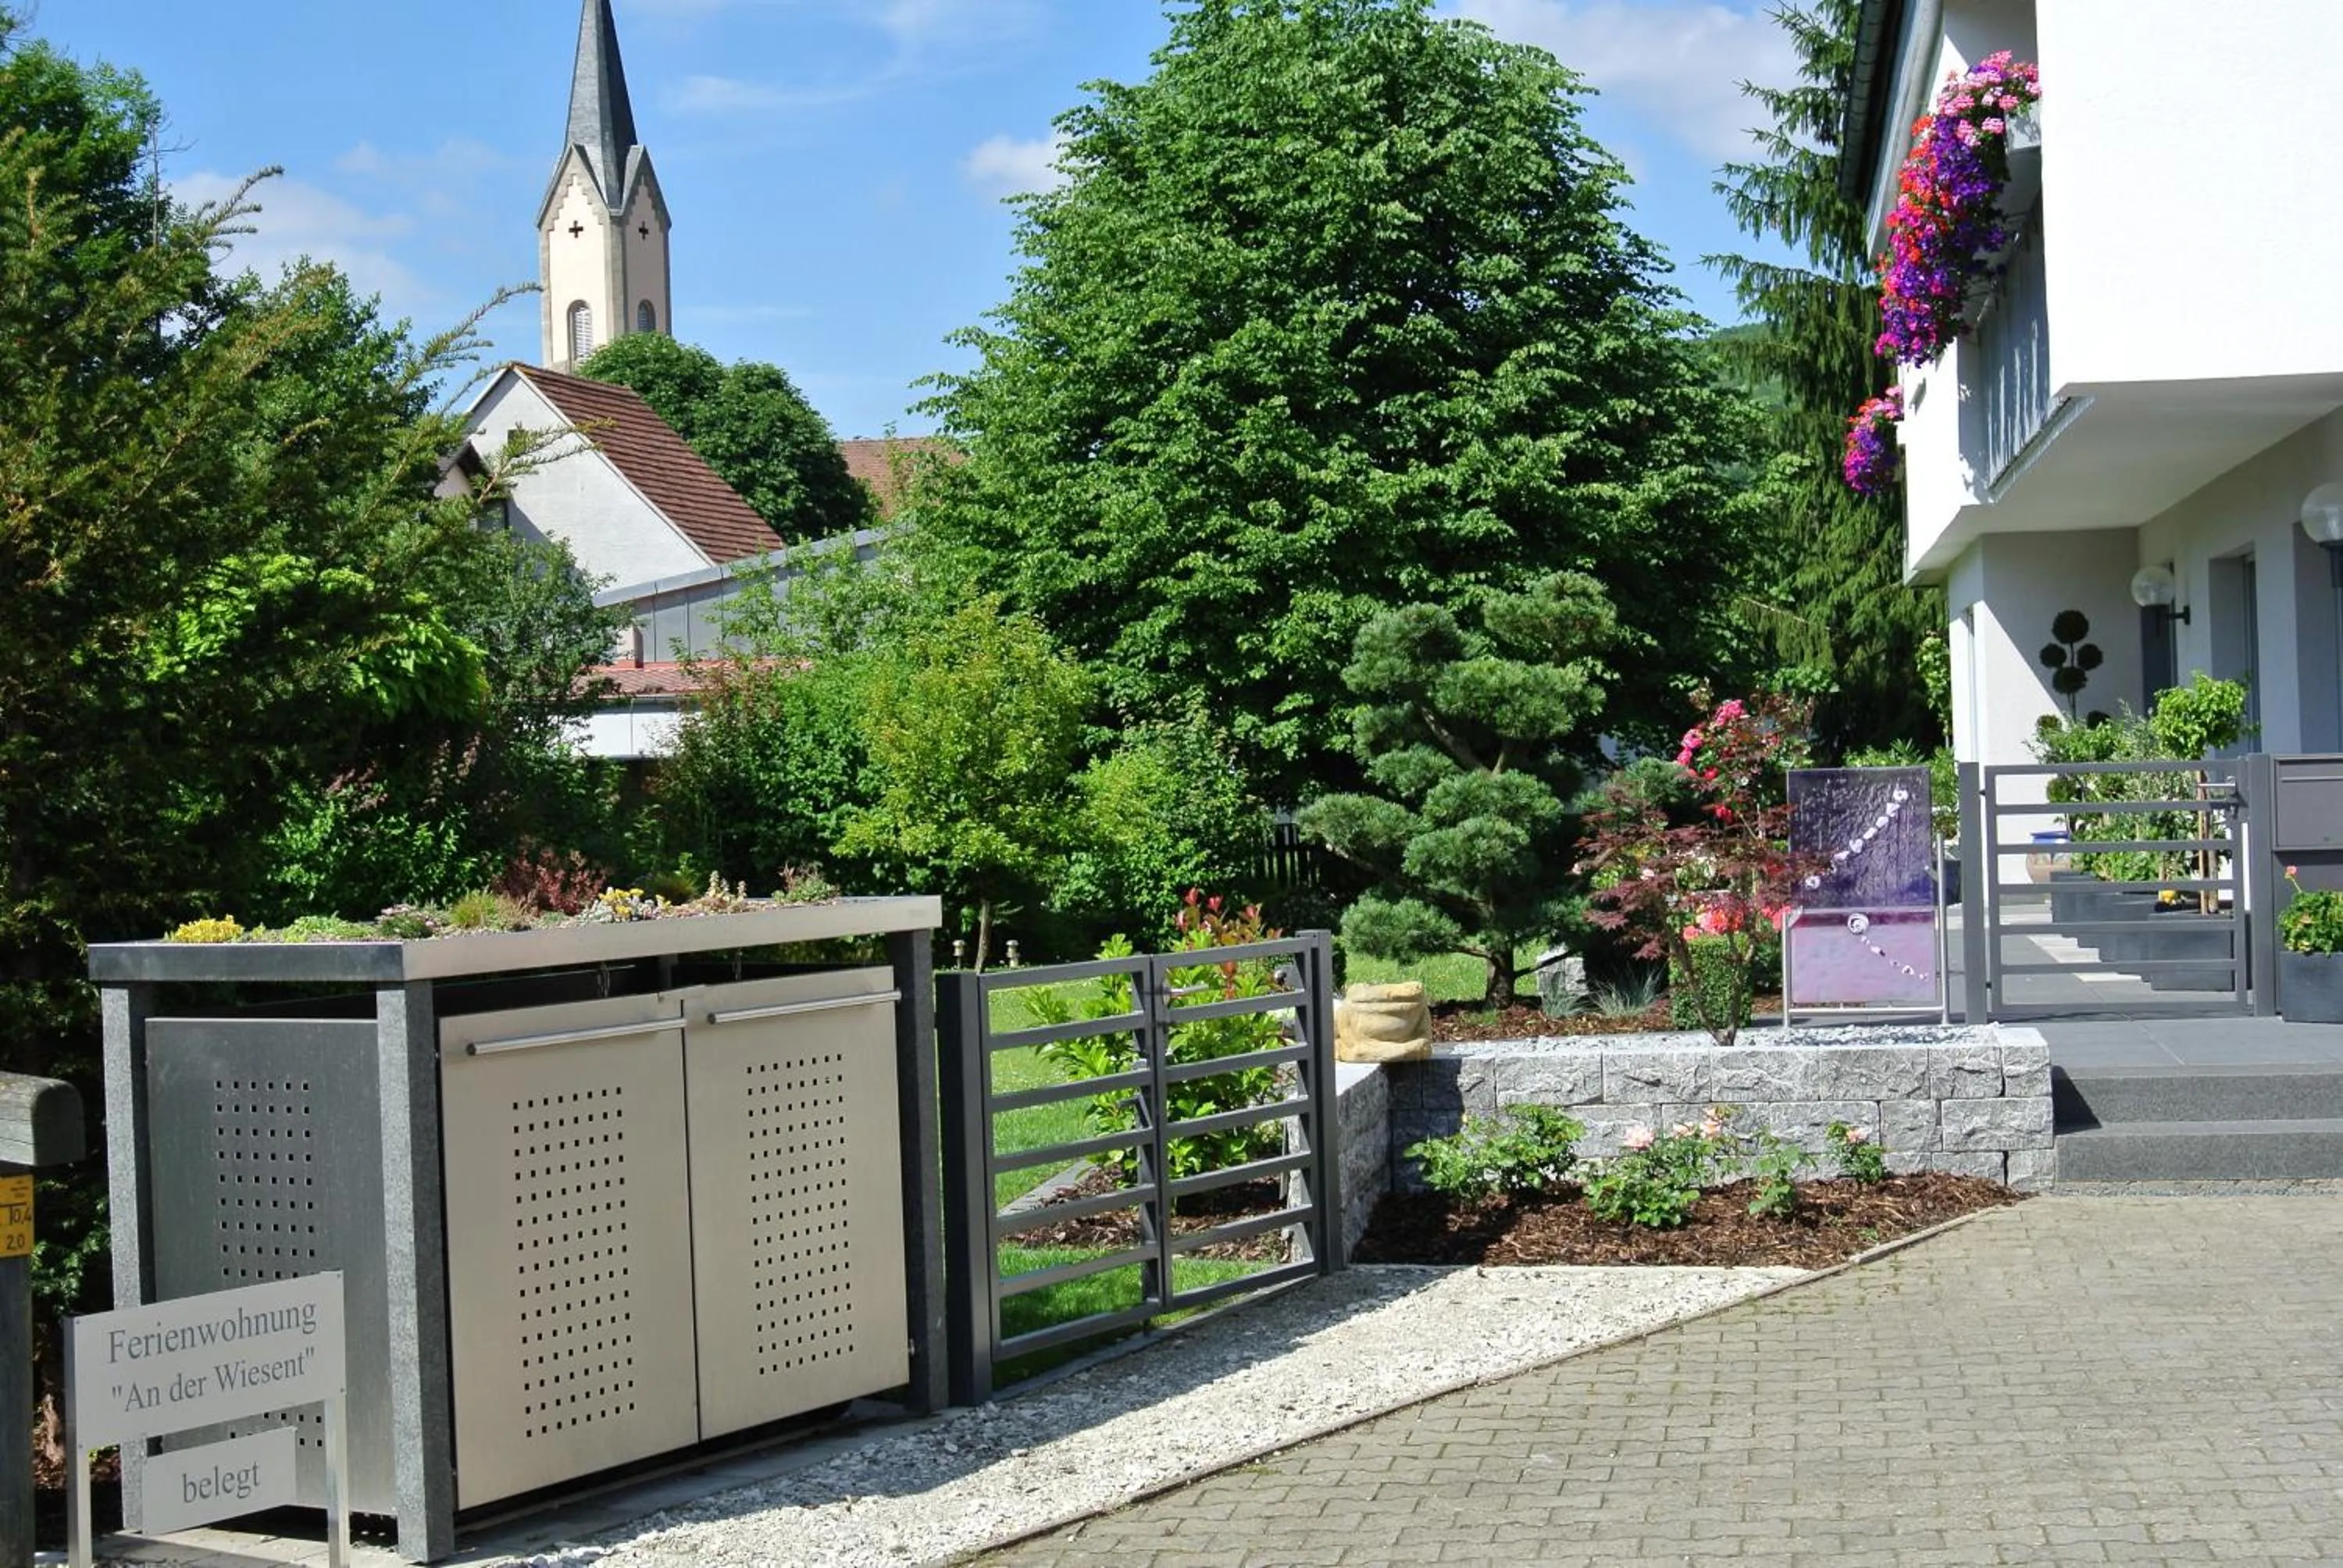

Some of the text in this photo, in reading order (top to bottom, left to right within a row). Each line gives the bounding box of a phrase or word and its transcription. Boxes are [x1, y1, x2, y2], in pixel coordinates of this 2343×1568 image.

[106, 1303, 317, 1364] Ferienwohnung
[111, 1346, 316, 1412] "An der Wiesent"
[181, 1460, 261, 1503] belegt
